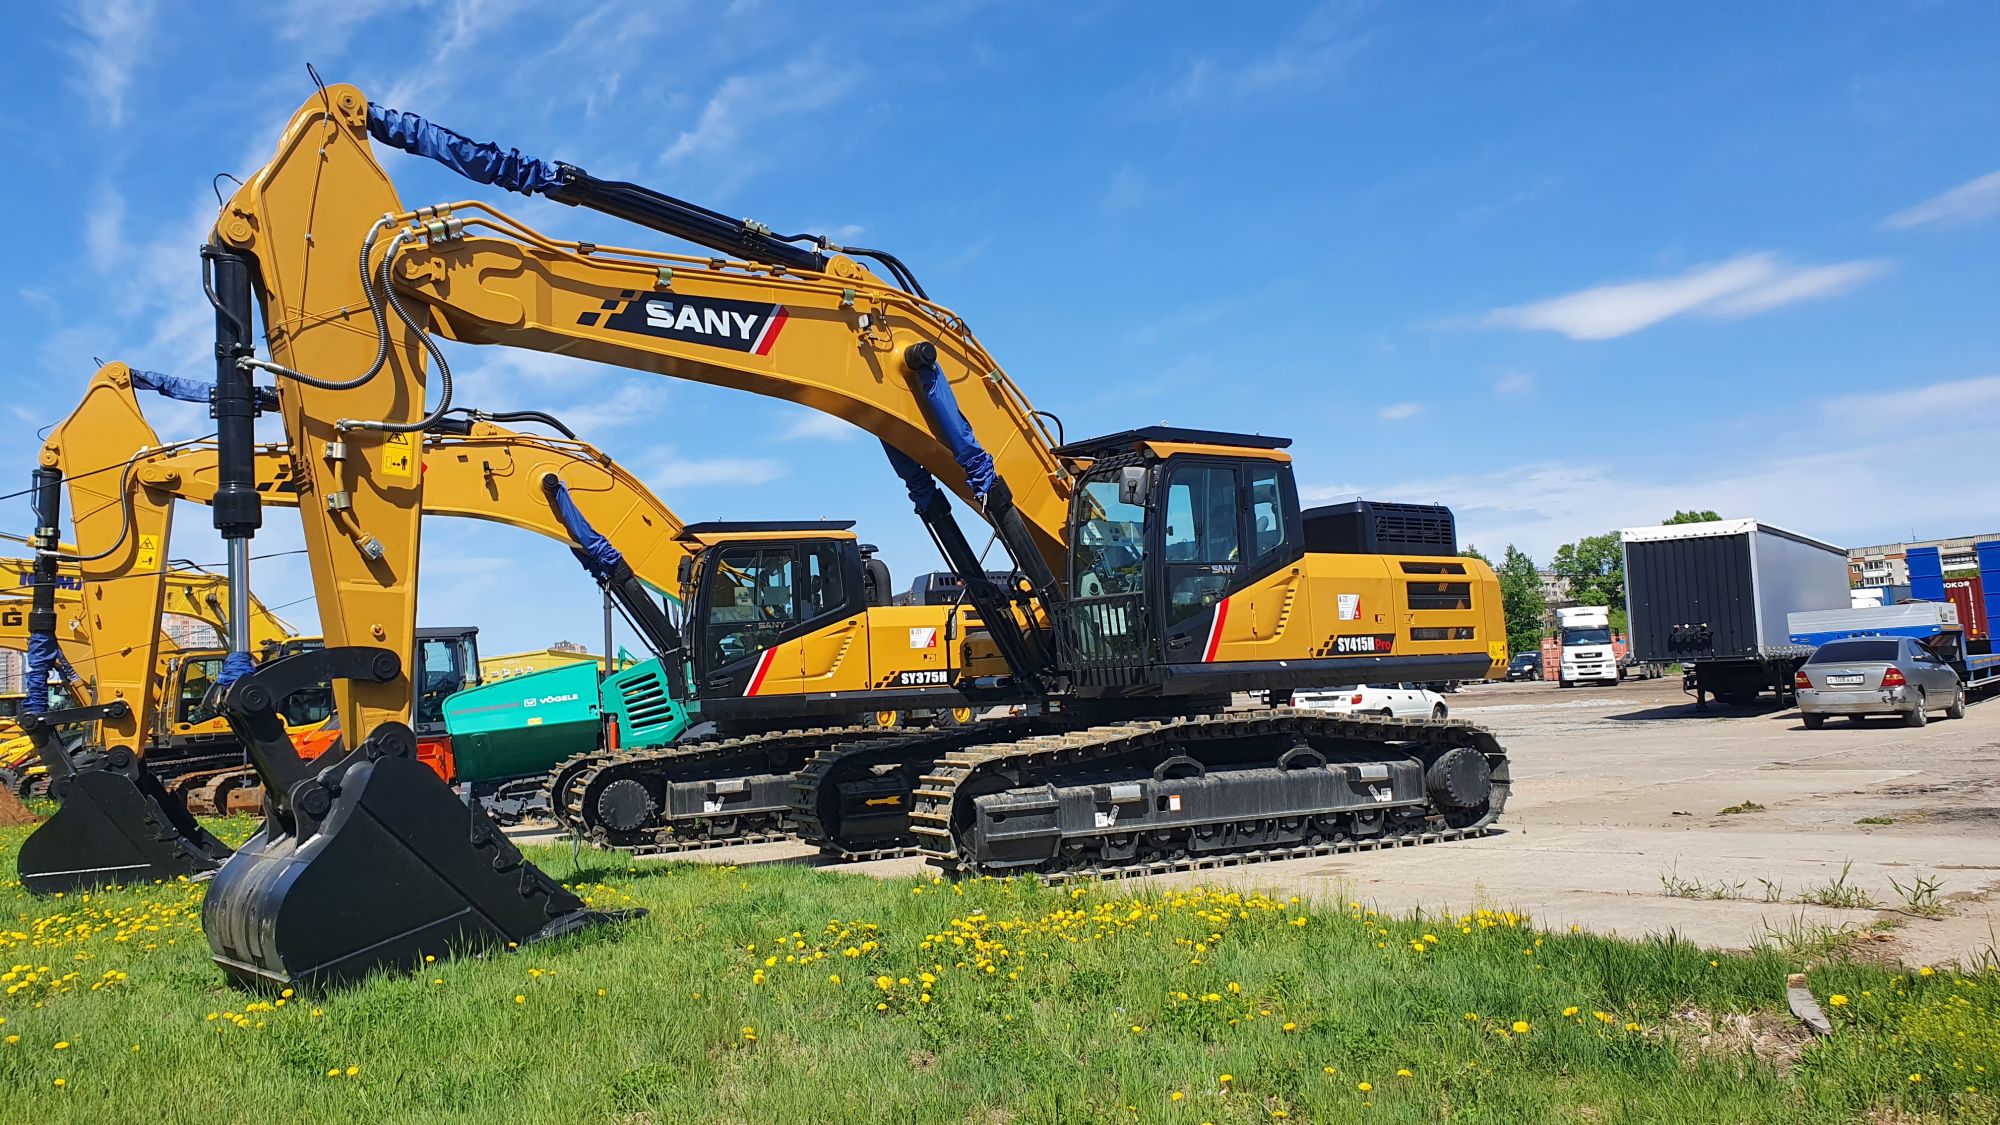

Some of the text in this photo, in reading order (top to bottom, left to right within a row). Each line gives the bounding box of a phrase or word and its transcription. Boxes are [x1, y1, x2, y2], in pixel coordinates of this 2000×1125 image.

[645, 299, 759, 340] SANY
[1211, 565, 1237, 574] SANY
[758, 621, 786, 629] SANY
[1337, 636, 1391, 652] SY415H Pro
[901, 670, 948, 686] SY375H
